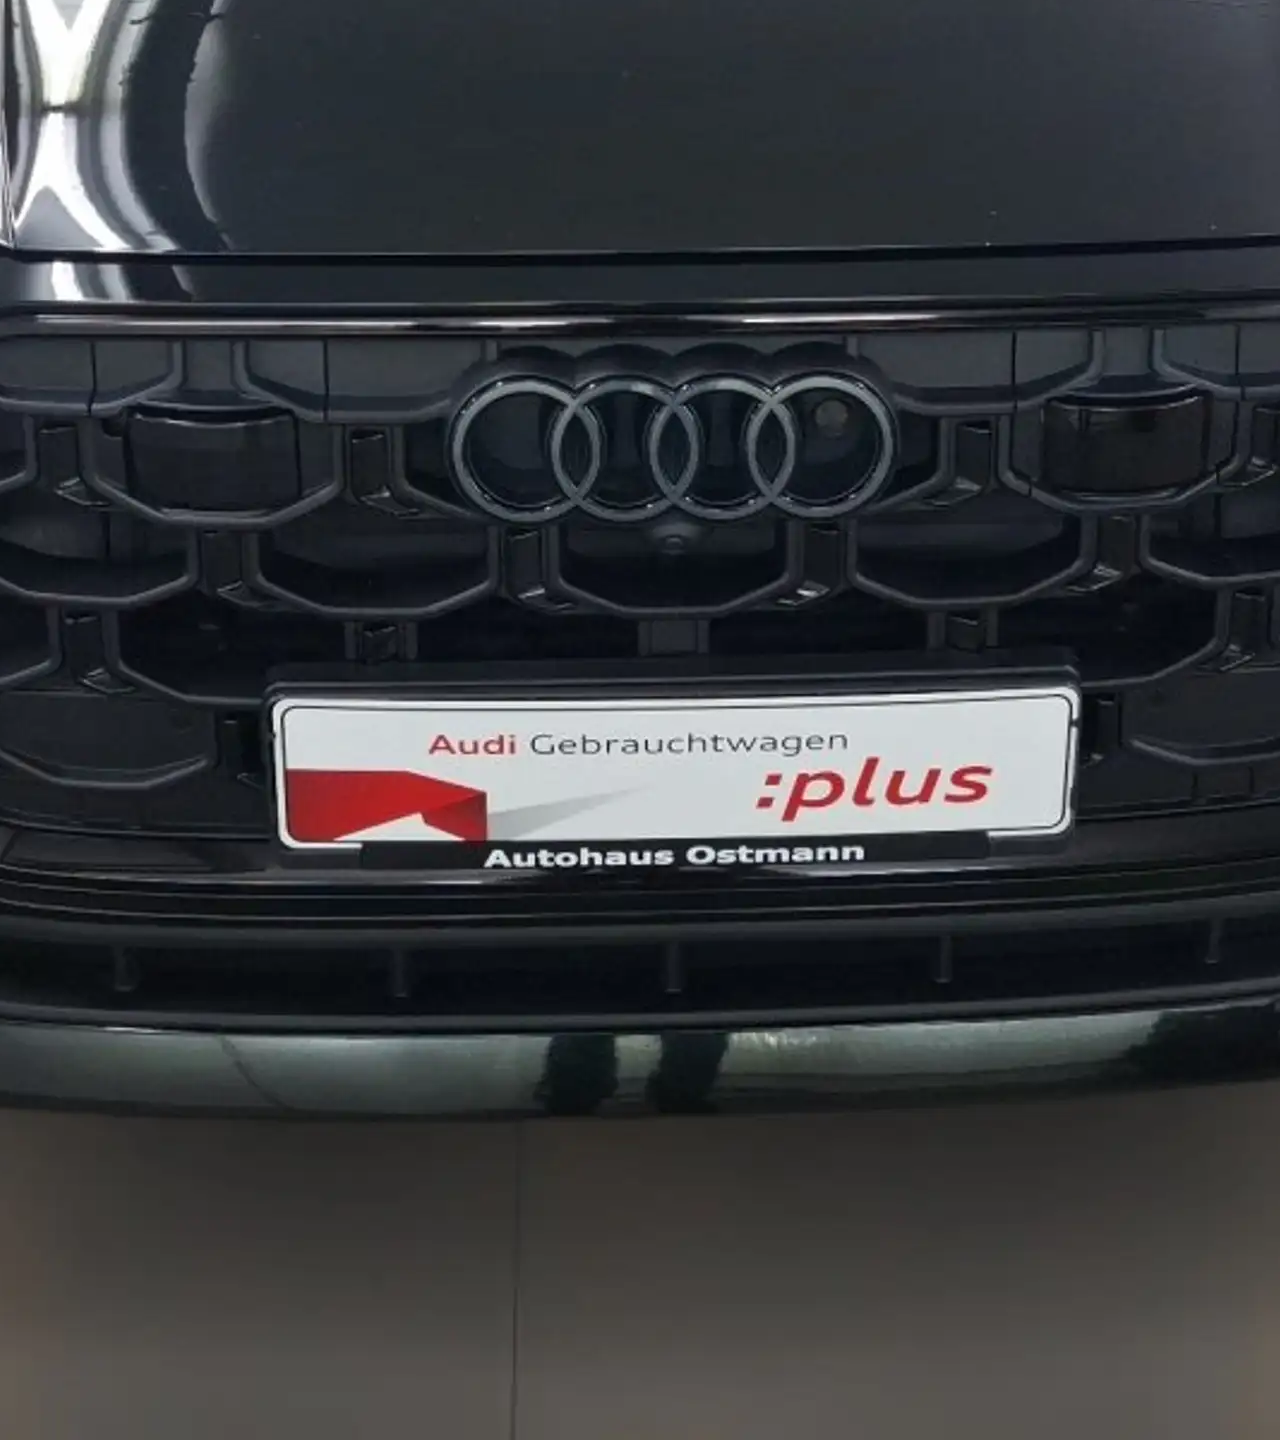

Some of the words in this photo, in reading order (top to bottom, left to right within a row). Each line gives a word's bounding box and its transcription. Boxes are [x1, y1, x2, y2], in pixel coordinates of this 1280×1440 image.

[428, 733, 517, 756] Audi
[530, 732, 848, 757] Gebrauchtwagen
[756, 756, 993, 822] :plus
[484, 847, 674, 868] Autohaus
[686, 844, 864, 864] Ostmann
